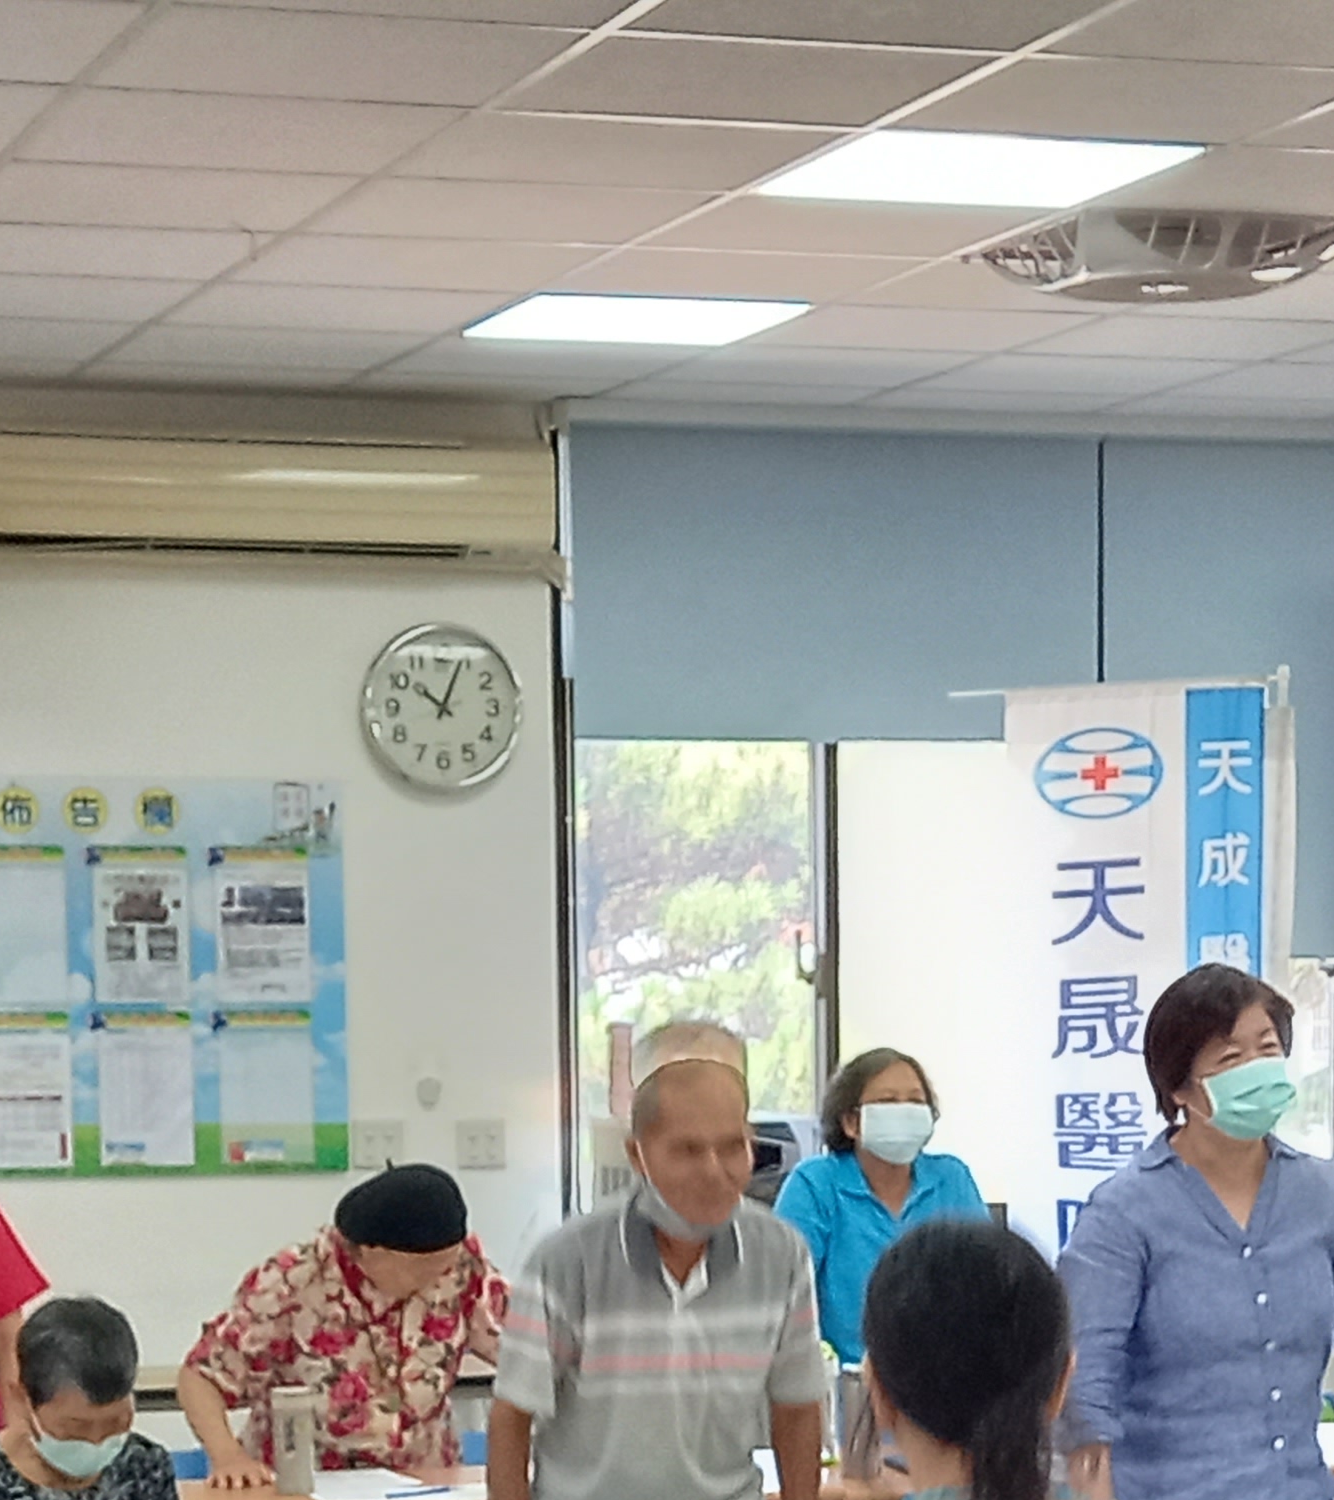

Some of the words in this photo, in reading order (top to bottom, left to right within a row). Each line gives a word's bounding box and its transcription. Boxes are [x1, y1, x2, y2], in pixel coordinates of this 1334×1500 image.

[389, 671, 410, 690] 10
[478, 671, 493, 690] 2
[385, 697, 401, 717] 9
[485, 698, 500, 717] 3
[392, 724, 408, 743] 8
[478, 724, 494, 742] 4
[414, 742, 428, 762] 7
[436, 750, 451, 770] 6
[460, 742, 476, 763] 5
[1051, 856, 1149, 1246] 天晟醫
